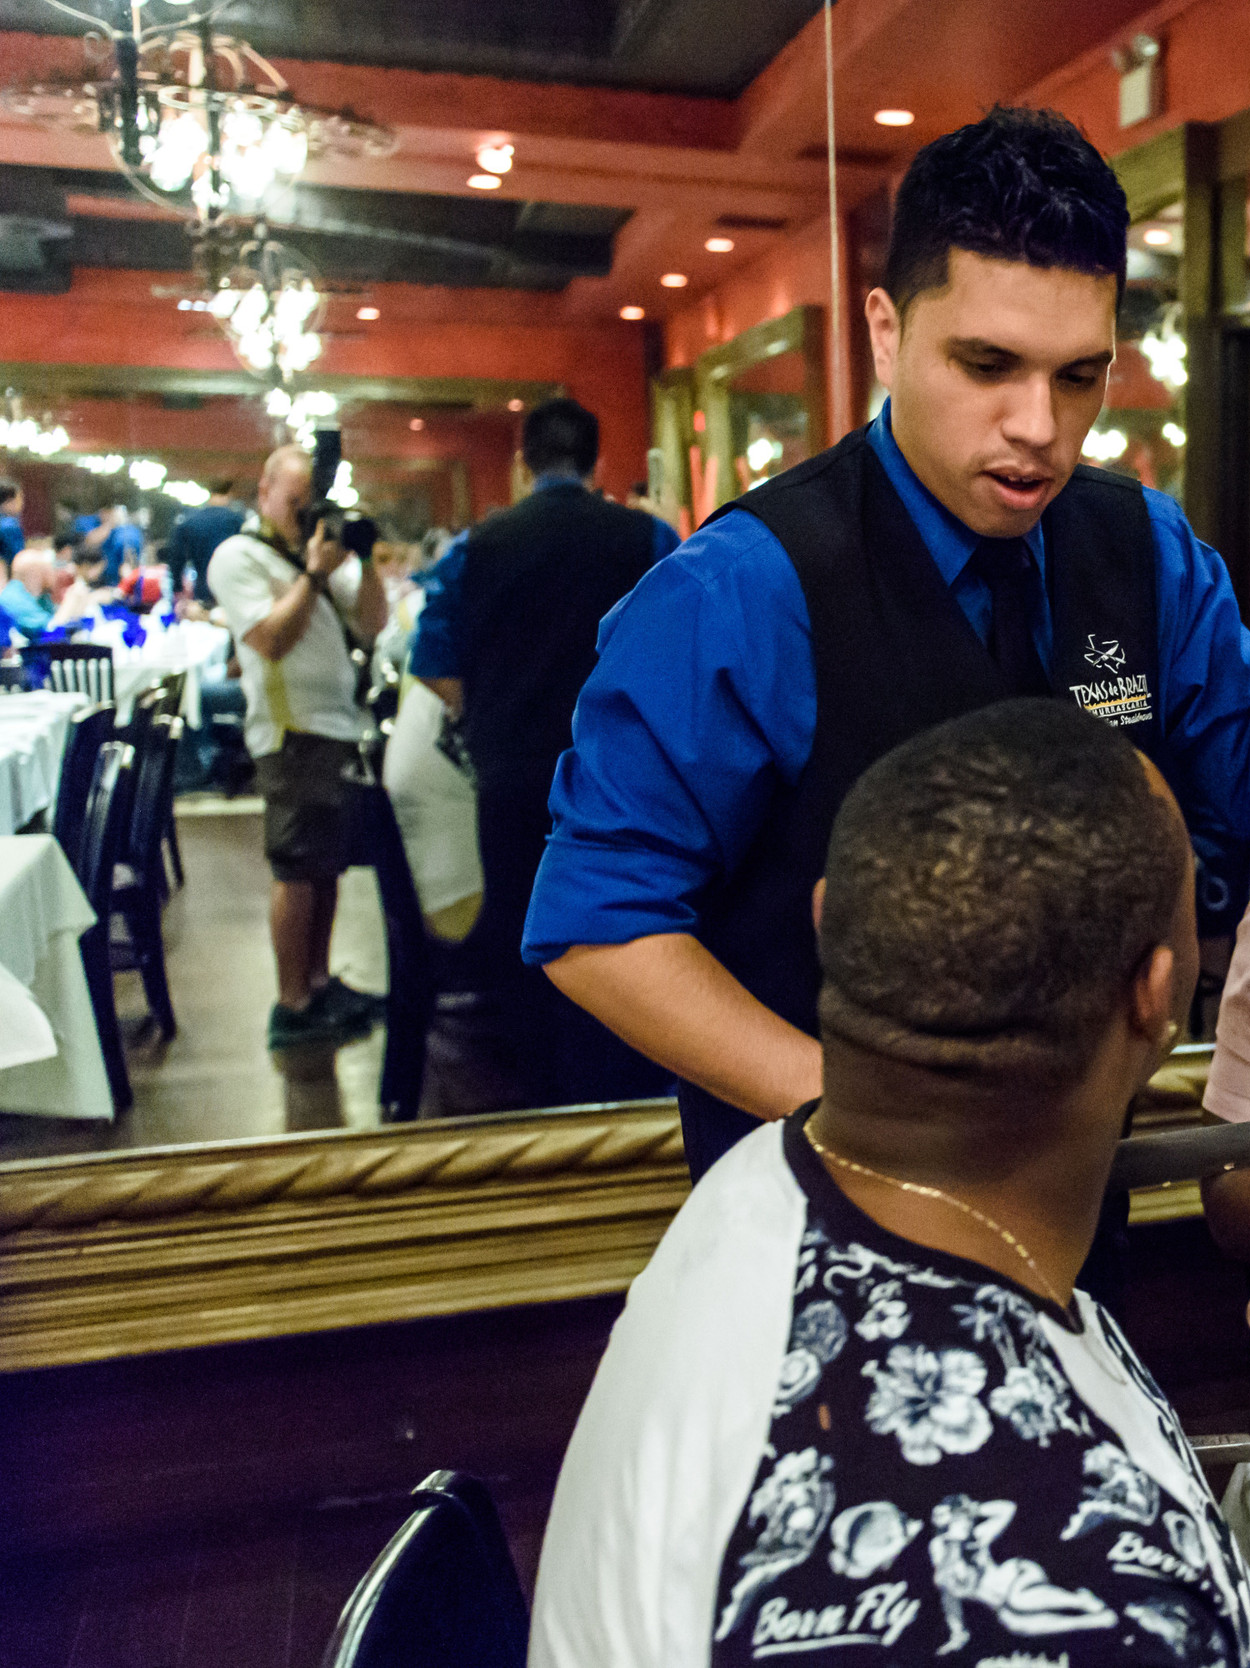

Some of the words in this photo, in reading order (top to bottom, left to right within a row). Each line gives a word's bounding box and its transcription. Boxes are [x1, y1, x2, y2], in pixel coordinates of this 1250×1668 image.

[1069, 680, 1109, 709] TEXAS
[1089, 700, 1148, 717] HURRASCARIA
[848, 1580, 921, 1646] Fly
